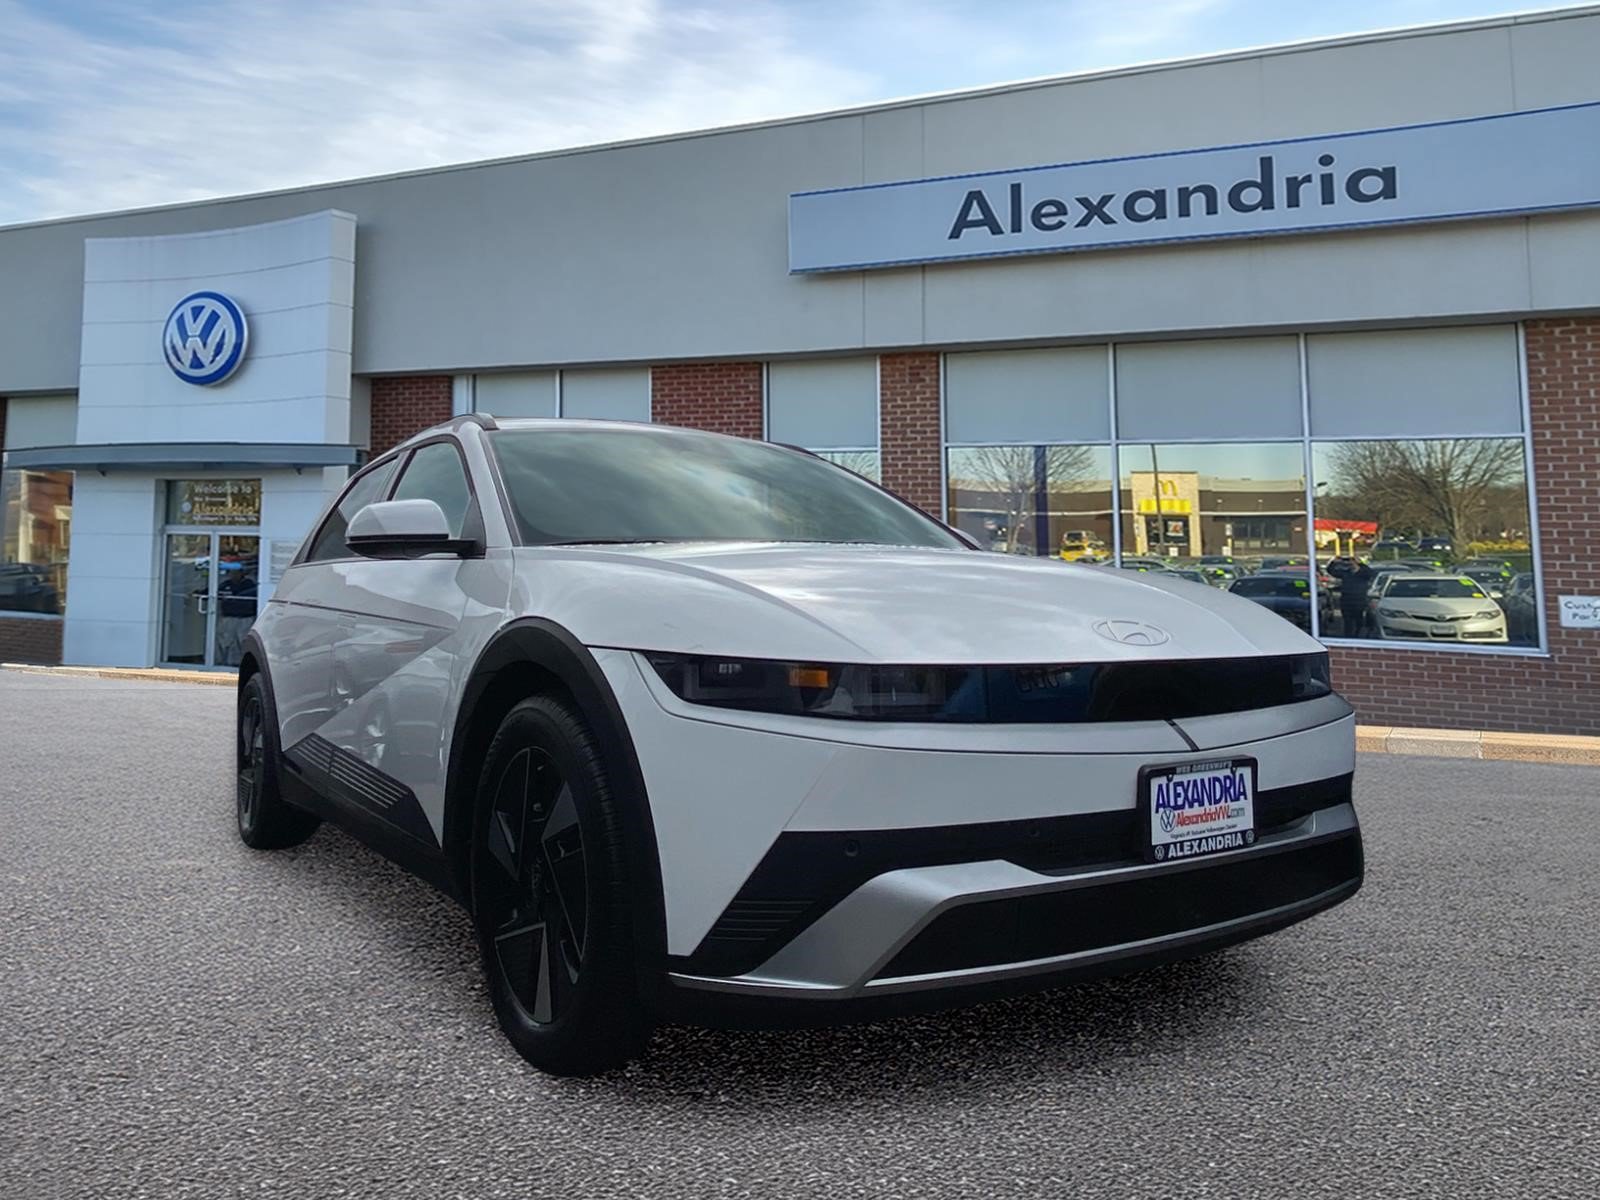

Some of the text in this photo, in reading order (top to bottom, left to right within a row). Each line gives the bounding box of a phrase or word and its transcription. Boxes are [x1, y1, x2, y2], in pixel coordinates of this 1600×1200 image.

[947, 153, 1398, 240] Alexandria
[165, 293, 240, 380] VW
[192, 502, 254, 514] Alexadria
[1155, 773, 1248, 813] ALEXANDRIA
[1167, 833, 1243, 858] ALEXANDRIA
